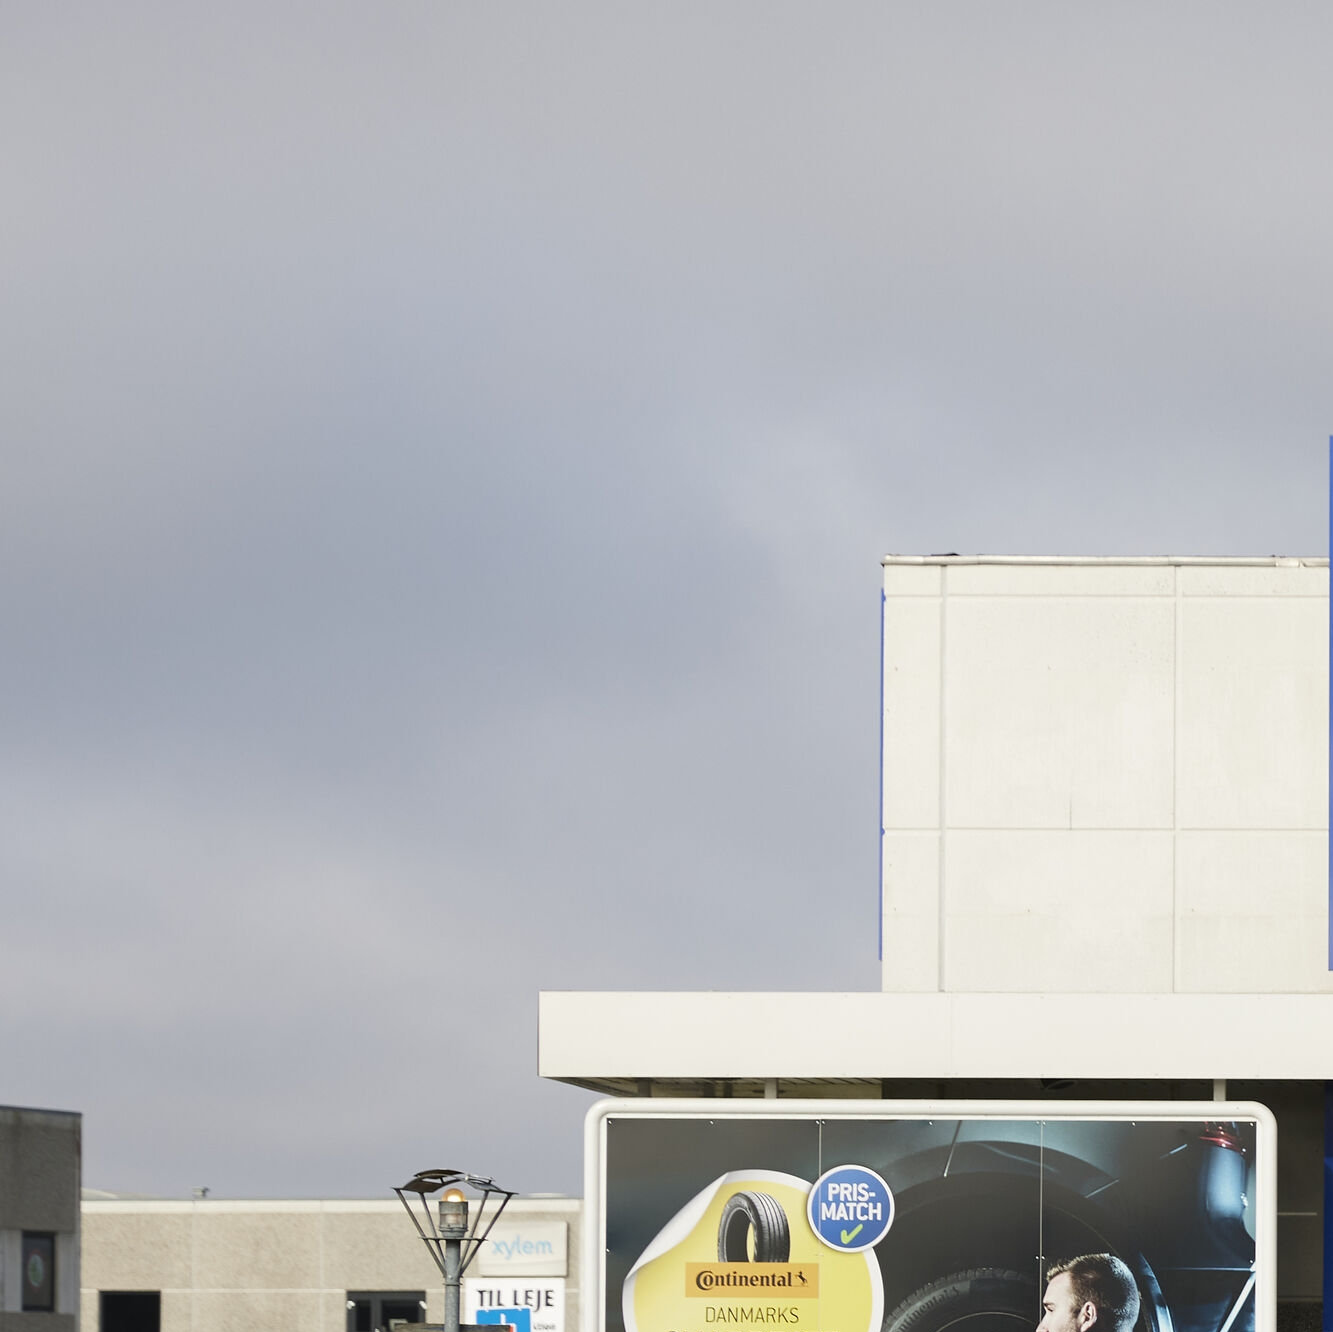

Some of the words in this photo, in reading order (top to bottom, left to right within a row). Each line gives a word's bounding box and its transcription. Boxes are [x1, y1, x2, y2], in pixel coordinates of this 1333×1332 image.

[828, 1183, 875, 1201] PRIS-
[821, 1203, 881, 1221] MATCH
[492, 1234, 552, 1260] xylem
[696, 1270, 792, 1290] Continental
[476, 1289, 504, 1306] TIL
[513, 1289, 554, 1312] LEJE
[705, 1307, 799, 1324] DANMARKS
